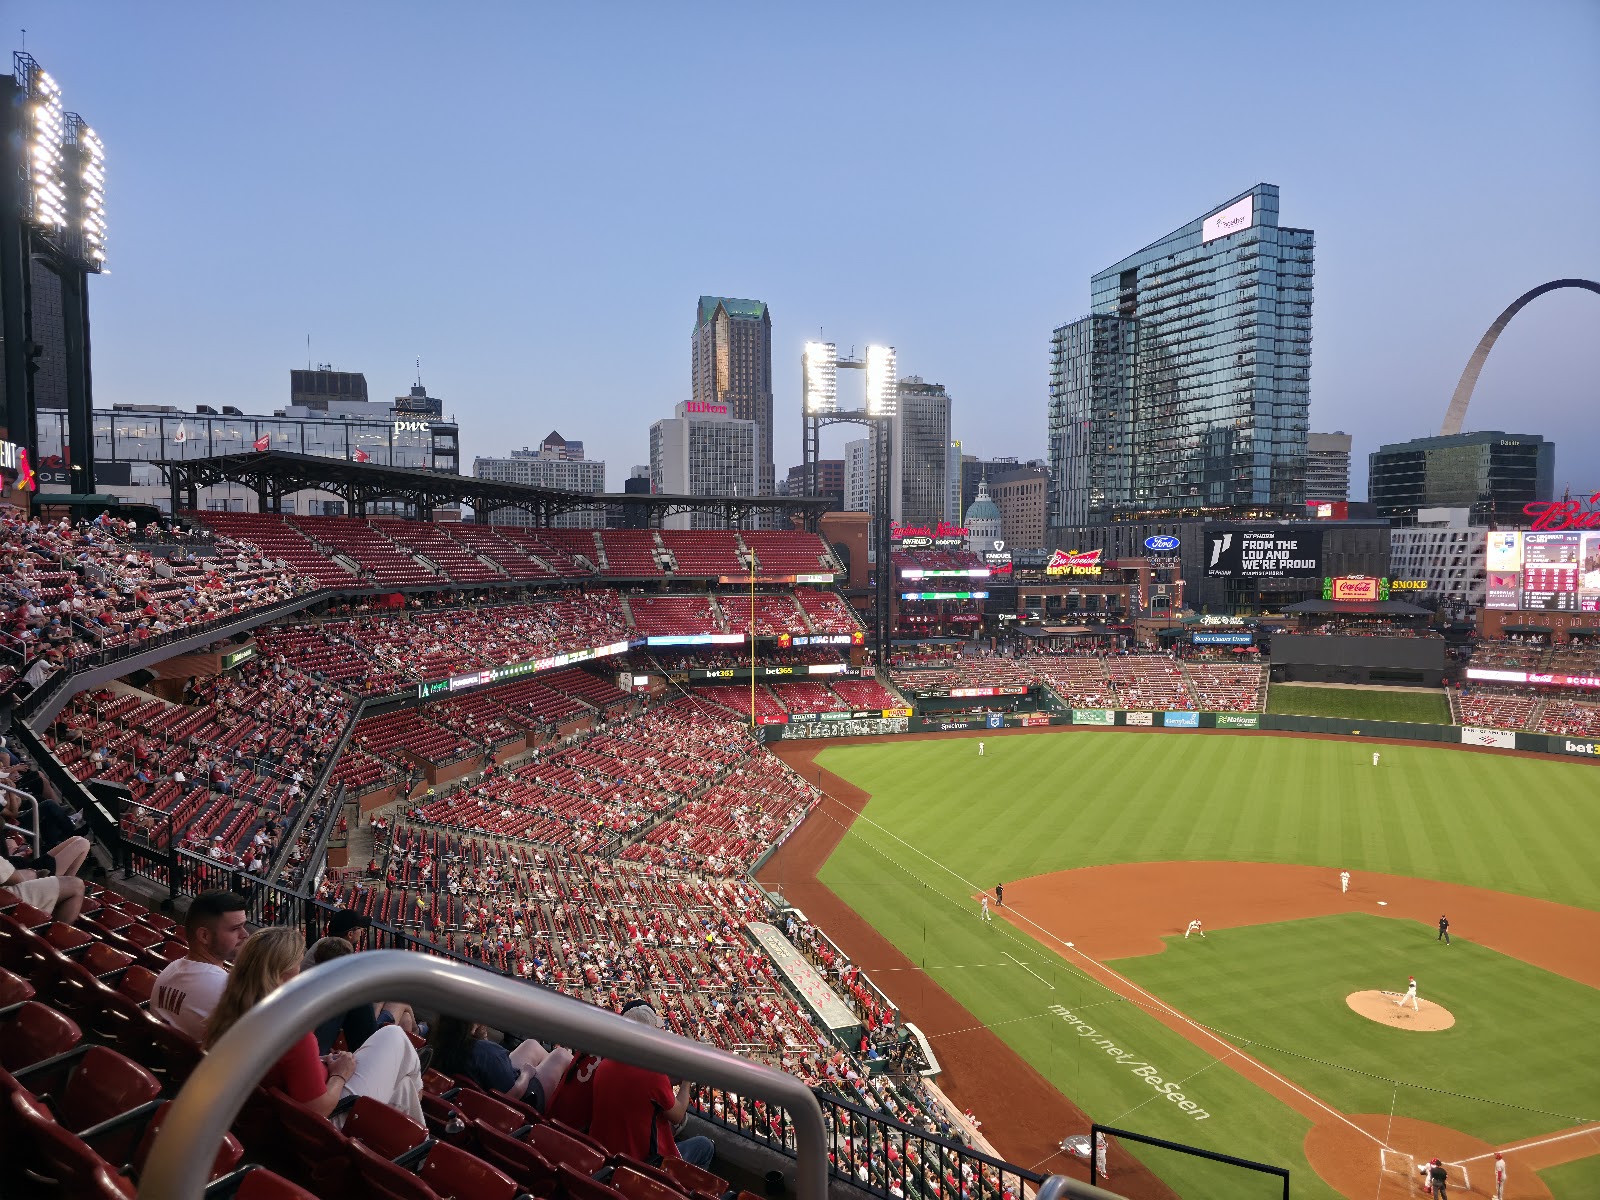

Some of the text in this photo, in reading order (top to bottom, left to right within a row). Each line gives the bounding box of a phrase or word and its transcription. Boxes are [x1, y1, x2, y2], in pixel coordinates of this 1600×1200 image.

[687, 401, 727, 414] Hilton
[393, 421, 430, 435] pwc
[1522, 491, 1600, 532] Bu
[931, 521, 969, 539] Nation
[1151, 537, 1173, 548] Ford
[1242, 540, 1298, 550] FROM THE
[1047, 553, 1101, 567] Budweiser
[1242, 550, 1290, 560] LOU AND
[1242, 560, 1316, 570] WE'RE PROUD
[1046, 566, 1102, 575] BREW HOUSE
[1339, 581, 1372, 592] Coca-Cola
[1392, 580, 1428, 589] SMOKE
[809, 635, 829, 645] MAC
[829, 635, 851, 644] LAND
[706, 670, 734, 678] bet365
[765, 667, 793, 675] bet365
[1226, 716, 1258, 725] National
[940, 722, 967, 731] Spectrum
[1048, 1004, 1211, 1121] mercy.net/BeSeen
